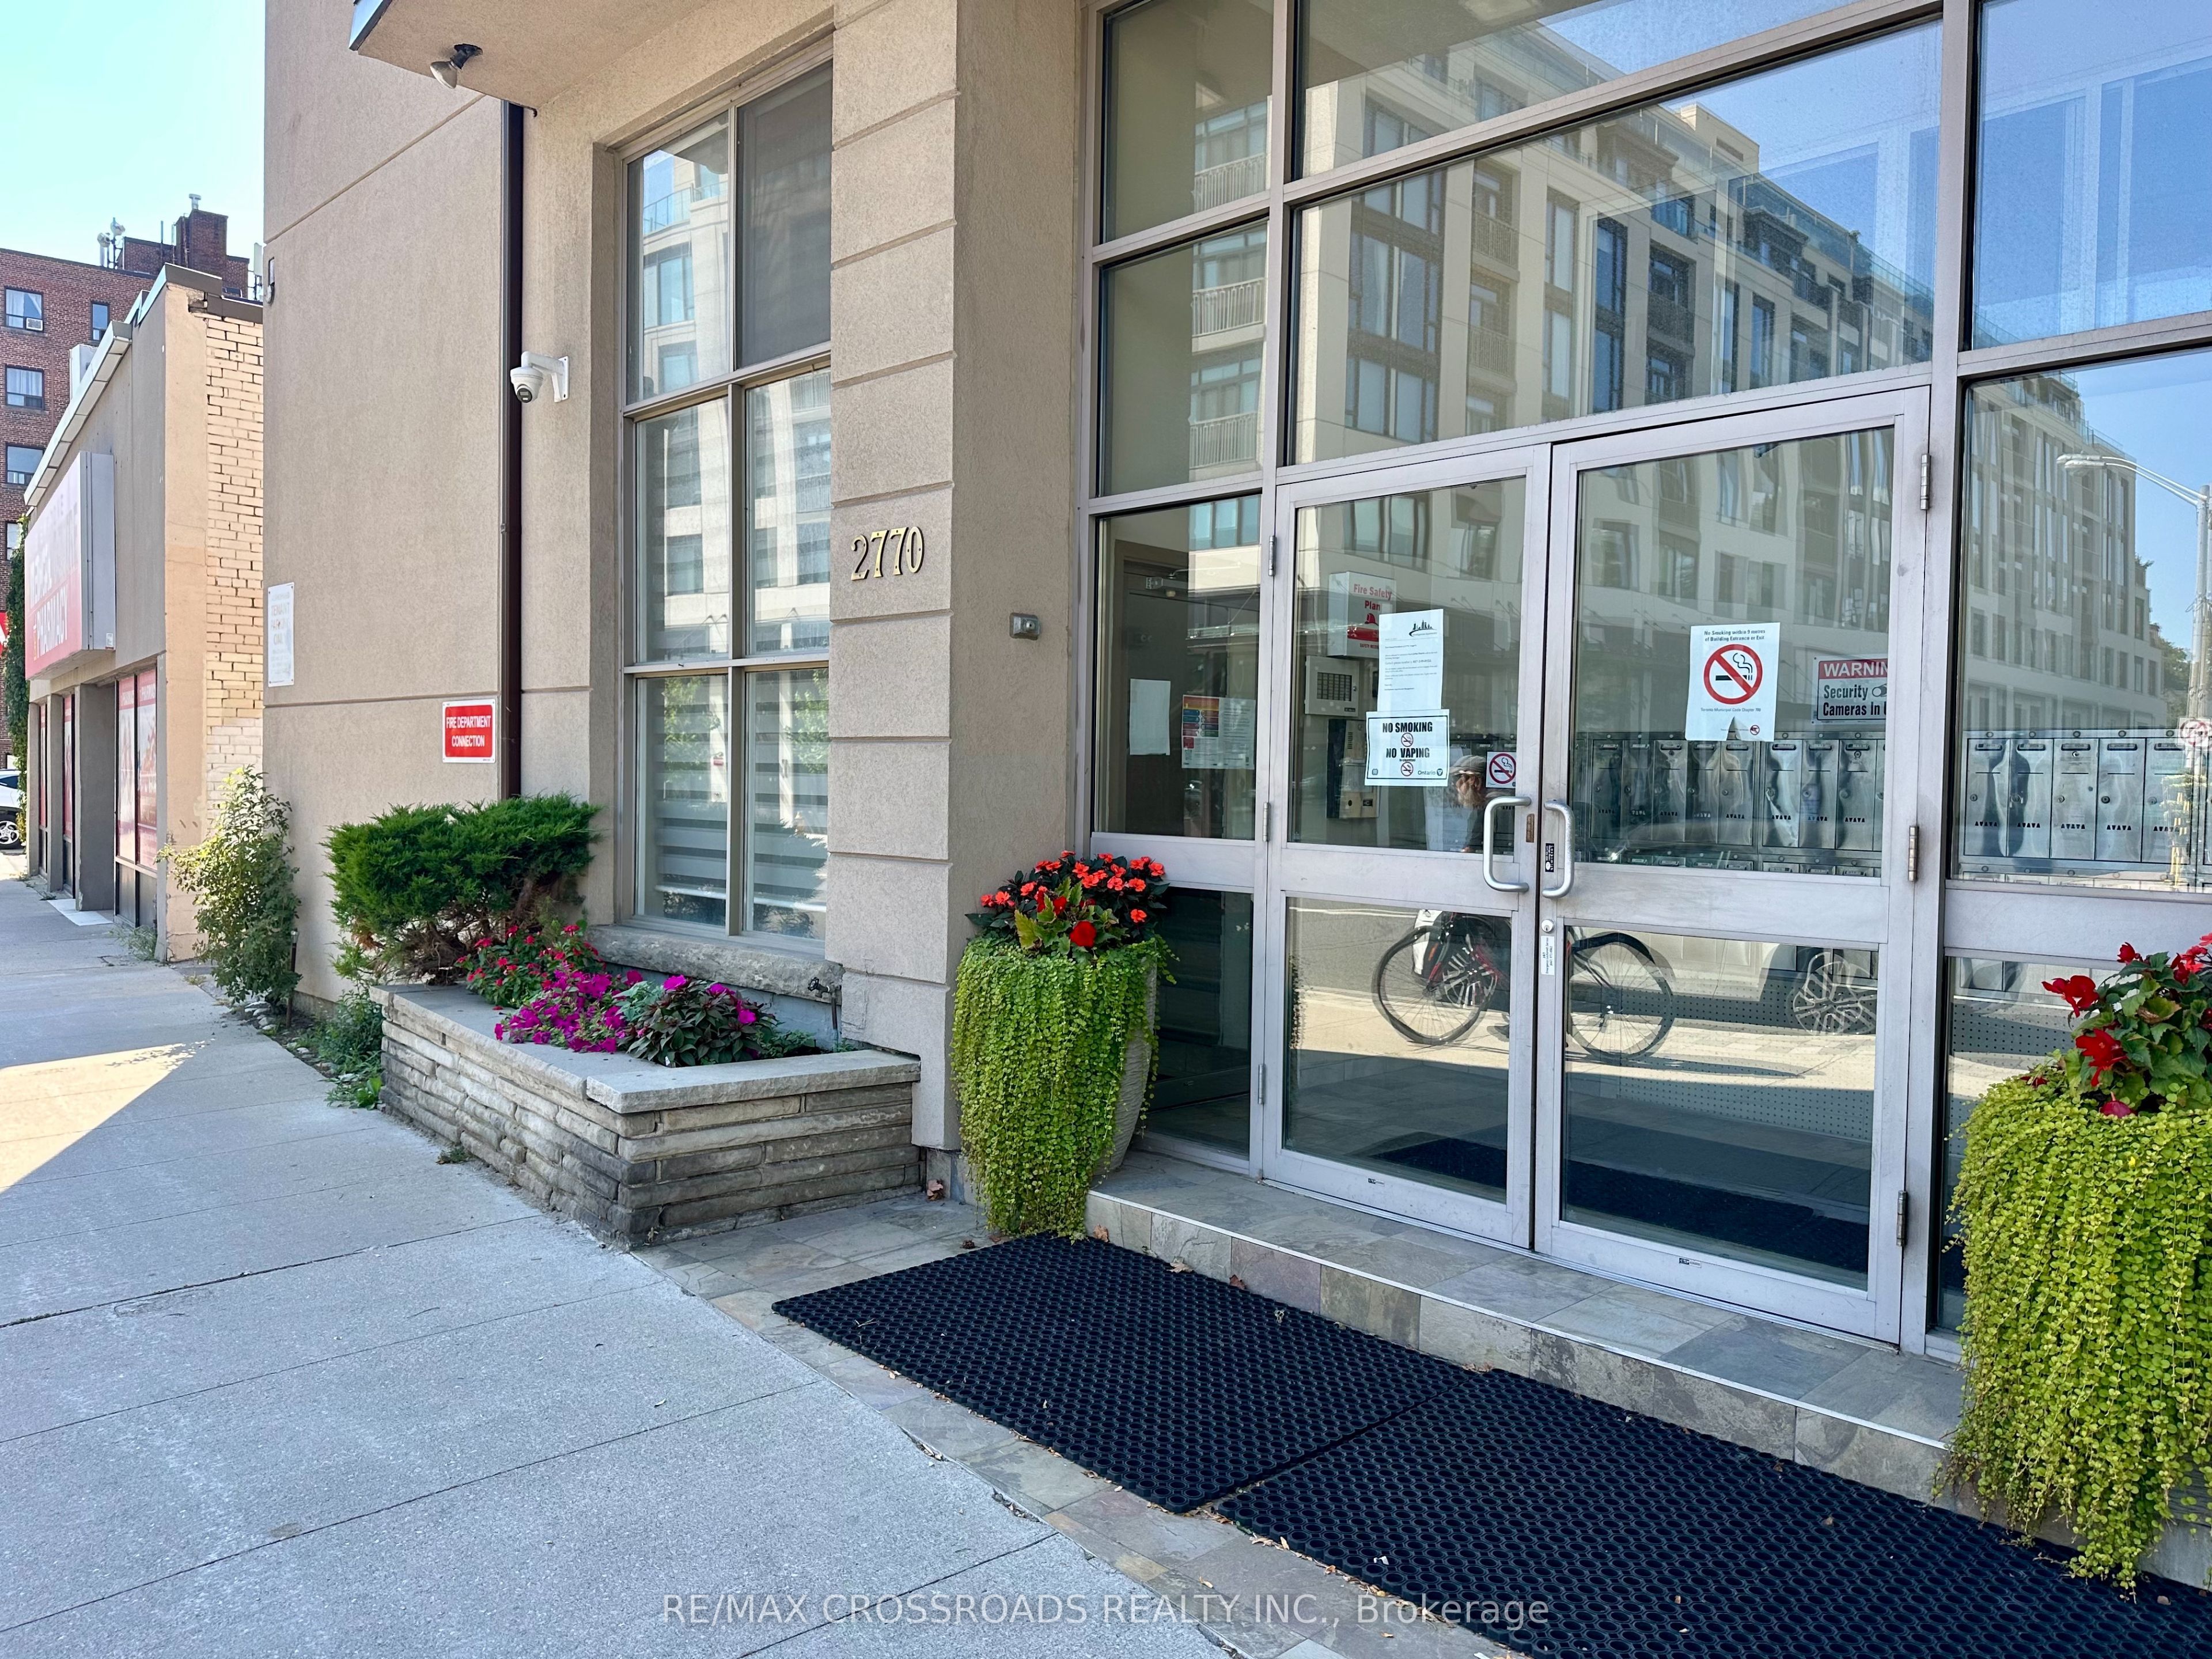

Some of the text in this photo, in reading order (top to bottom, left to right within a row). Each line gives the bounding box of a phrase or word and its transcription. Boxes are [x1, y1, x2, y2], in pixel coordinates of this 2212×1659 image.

[851, 526, 925, 581] 2770
[1354, 584, 1392, 600] Fire Safety
[1364, 600, 1381, 611] Plan
[37, 583, 68, 658] PHARMACY
[1824, 661, 1888, 677] WARNIN
[1824, 684, 1868, 700] Security
[1823, 702, 1866, 716] Cameras
[1870, 702, 1880, 715] In
[446, 715, 491, 729] FIRE DEPARTMENT
[1382, 721, 1433, 733] NO SMOKING
[452, 735, 485, 747] CONNECTION
[1386, 747, 1430, 758] NO VAPING
